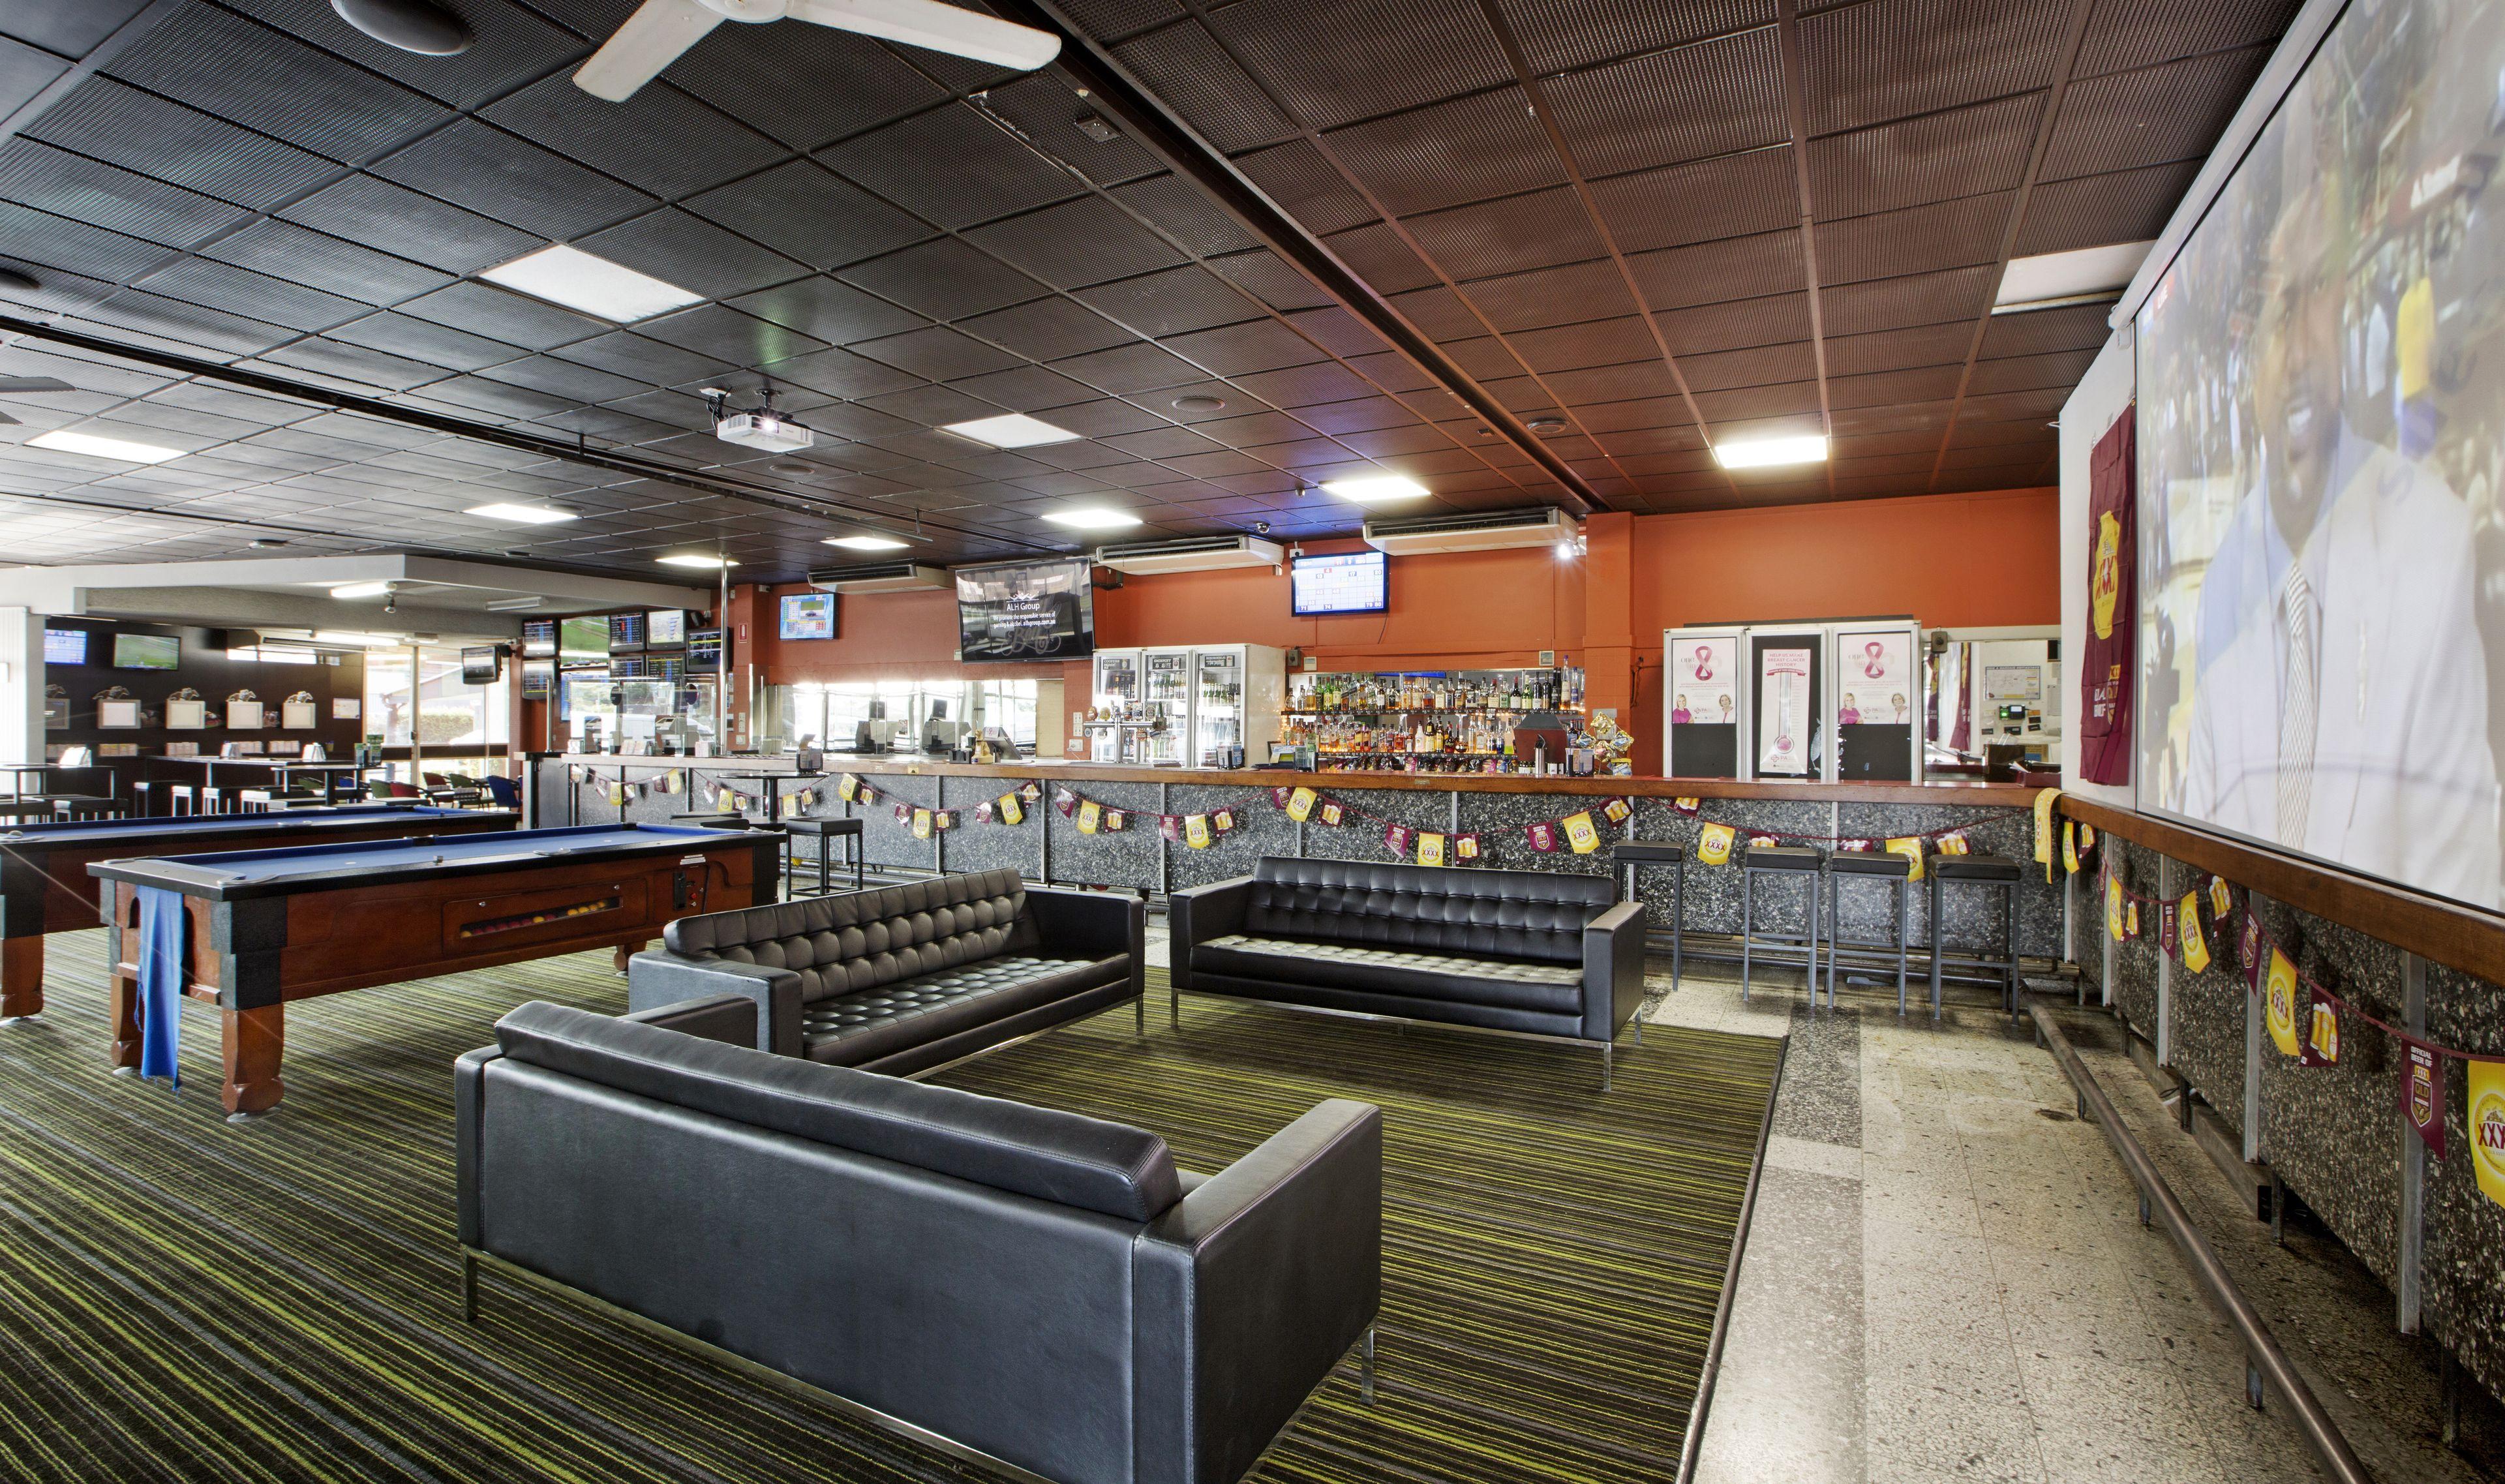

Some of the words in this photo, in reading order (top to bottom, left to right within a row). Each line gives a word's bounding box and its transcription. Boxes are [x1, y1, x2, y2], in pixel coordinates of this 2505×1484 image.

[1007, 603, 1020, 611] ALH
[1020, 602, 1040, 611] Group
[1293, 798, 1308, 810] XXXX
[1573, 829, 1592, 841] XXXX
[1705, 840, 1725, 851] XXXX
[2270, 992, 2290, 1022] XXXX
[2411, 1046, 2433, 1060] OFFICIAL
[2411, 1053, 2424, 1065] BEER
[2425, 1059, 2433, 1068] OF
[2415, 1083, 2429, 1098] QLD
